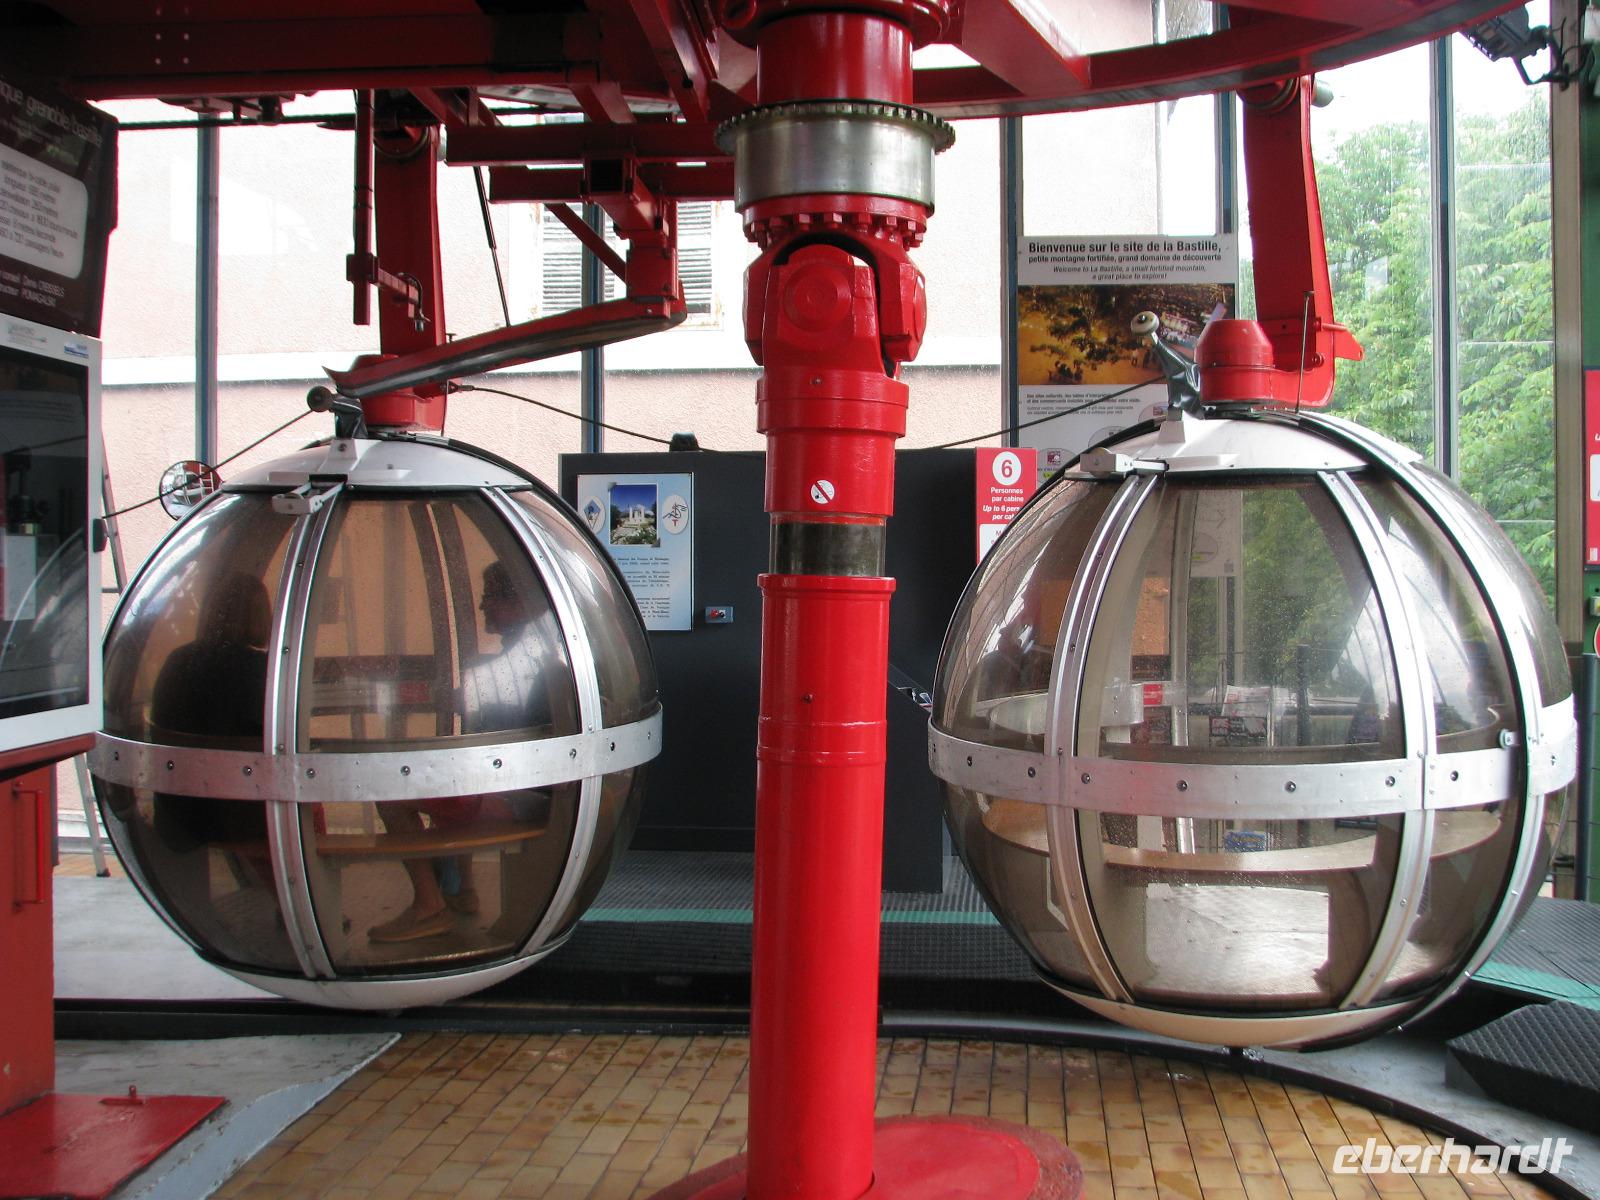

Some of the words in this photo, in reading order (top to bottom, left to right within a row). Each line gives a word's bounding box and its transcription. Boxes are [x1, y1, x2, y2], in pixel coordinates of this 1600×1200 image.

[1029, 242, 1086, 253] Bienvenue
[1089, 243, 1107, 253] sur
[1110, 242, 1120, 252] le
[1123, 241, 1143, 252] site
[1147, 241, 1160, 251] de
[1163, 241, 1173, 251] la
[1177, 240, 1221, 252] Bastille,
[1029, 255, 1049, 264] petite
[1050, 255, 1086, 263] montagne
[1118, 254, 1139, 263] grand
[1182, 253, 1222, 261] découverte
[1001, 459, 1013, 478] 6
[990, 486, 1024, 494] Personnes
[982, 505, 992, 513] Up
[1006, 505, 1021, 513] pers
